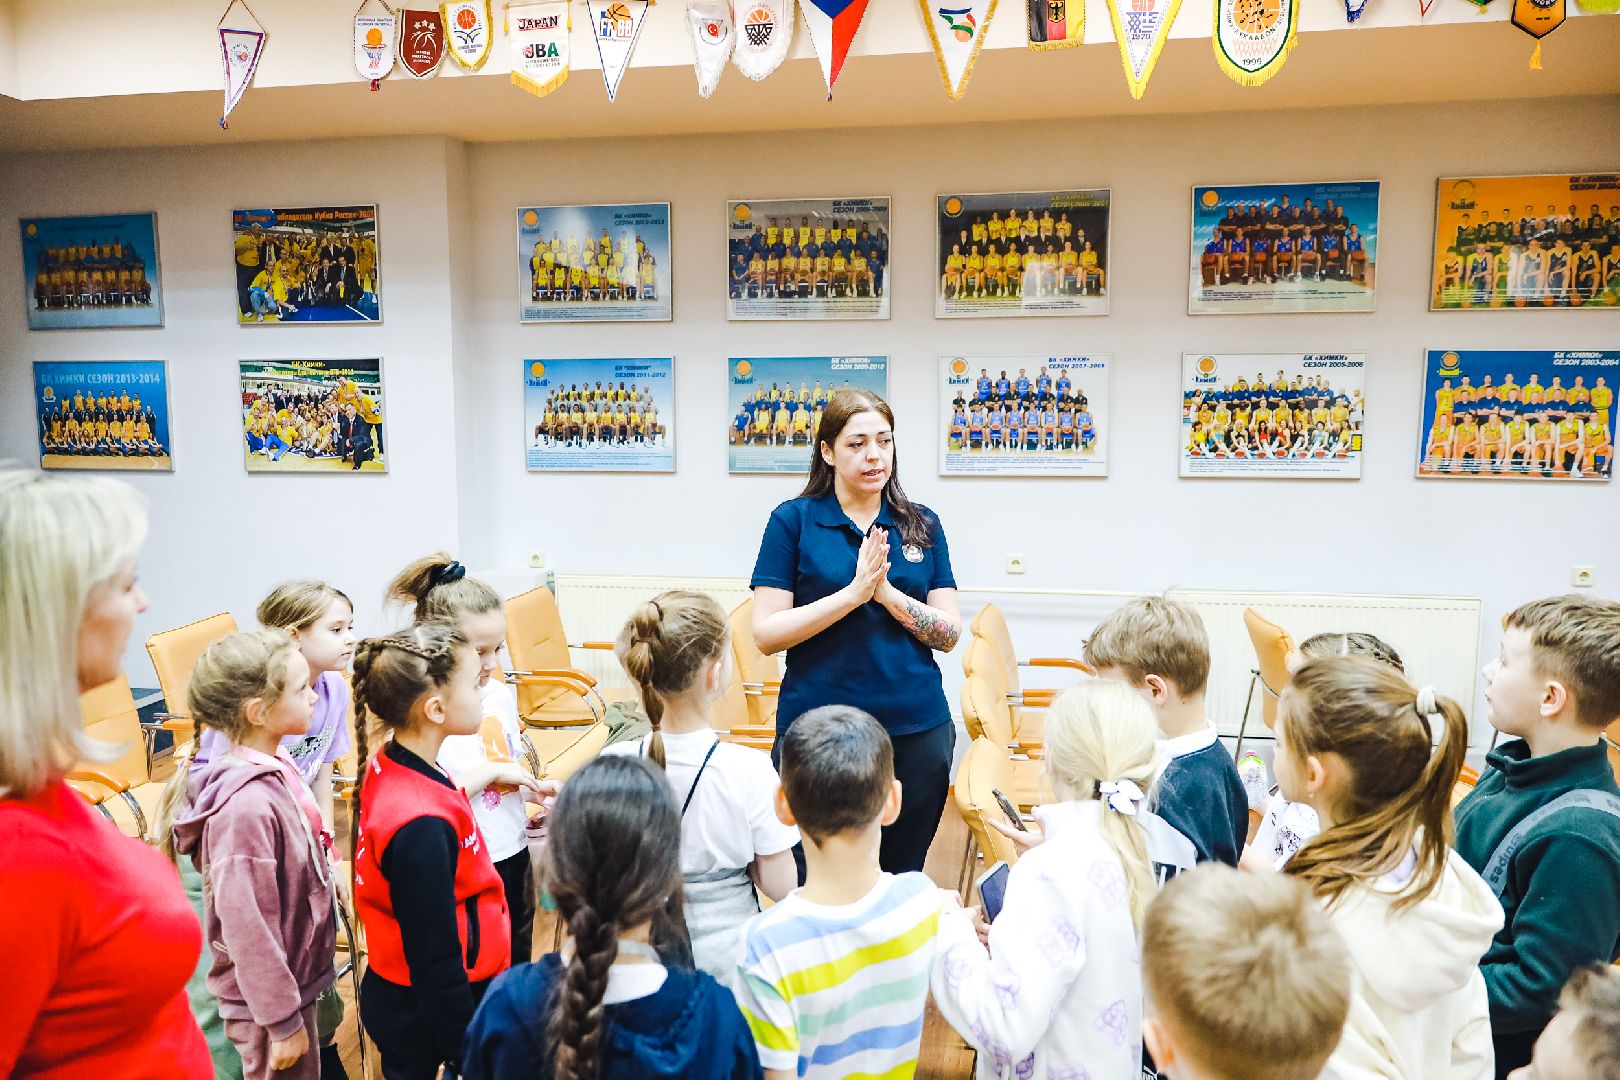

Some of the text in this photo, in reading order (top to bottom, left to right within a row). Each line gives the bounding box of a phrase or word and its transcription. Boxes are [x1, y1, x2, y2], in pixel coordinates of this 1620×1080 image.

[518, 16, 559, 30] JAPAN
[522, 42, 560, 58] JBA
[55, 374, 85, 384] ХИМКИ
[87, 374, 114, 384] СЕЗОН
[116, 373, 161, 384] 2013-2014
